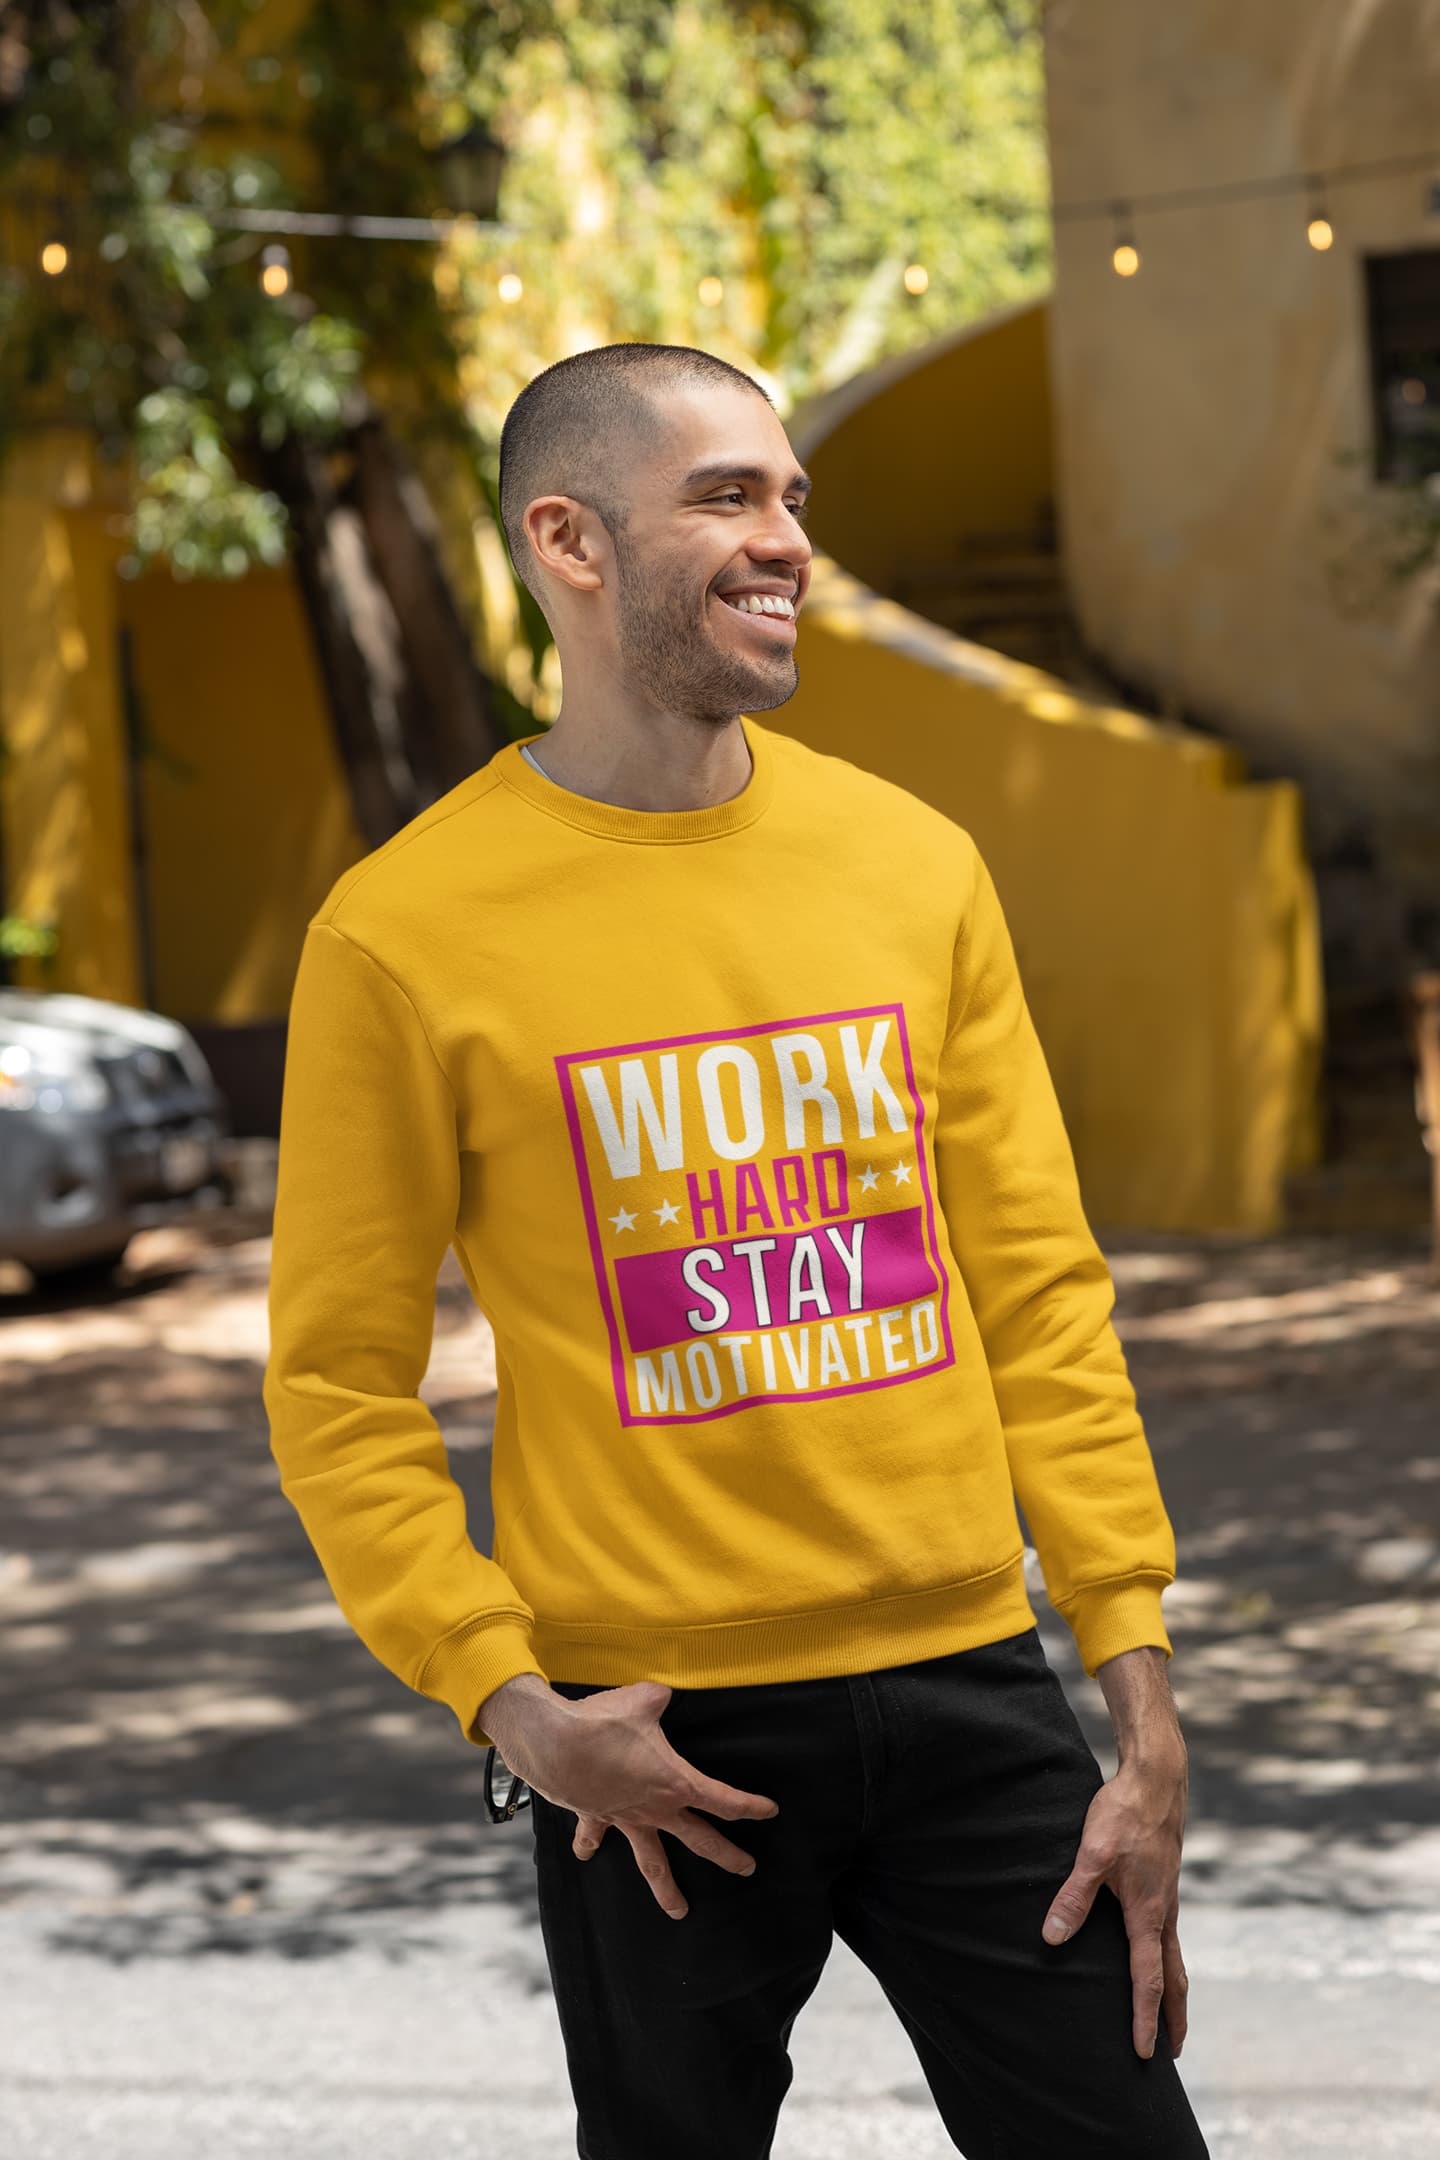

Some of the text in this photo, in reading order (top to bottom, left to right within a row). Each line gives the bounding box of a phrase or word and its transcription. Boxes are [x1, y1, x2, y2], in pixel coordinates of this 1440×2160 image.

[578, 1020, 908, 1180] WORK
[685, 1149, 850, 1240] HARD
[681, 1220, 867, 1333] STAY
[634, 1300, 940, 1413] MOTIVATED
